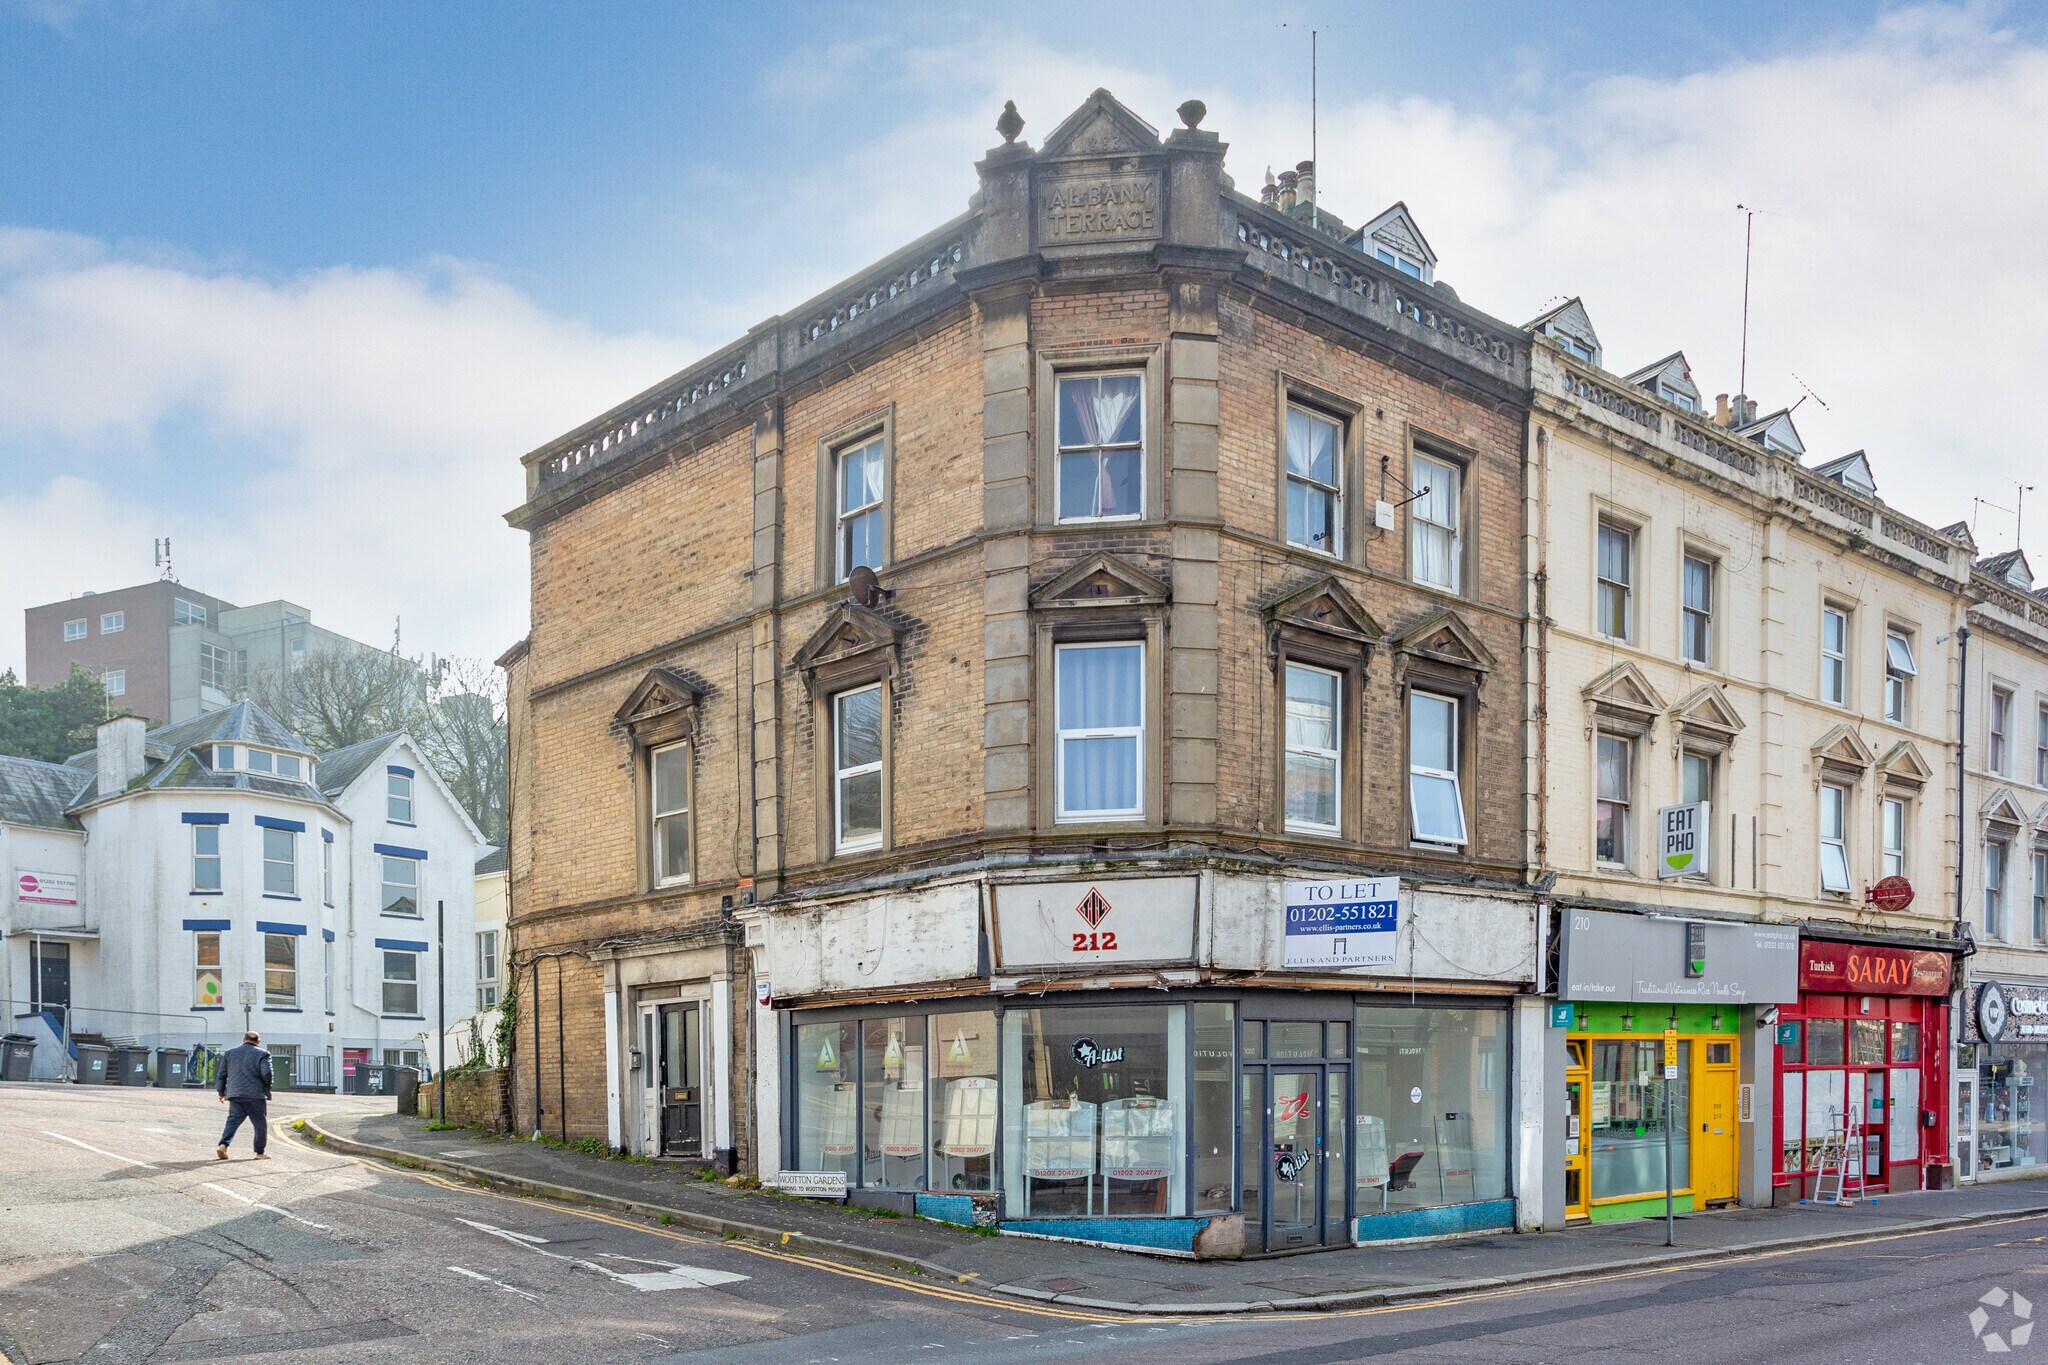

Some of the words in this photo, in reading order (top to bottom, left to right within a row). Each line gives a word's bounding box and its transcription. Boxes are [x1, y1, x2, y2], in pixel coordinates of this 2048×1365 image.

[1048, 182, 1152, 210] ALBANY
[1048, 209, 1153, 235] TERRACE
[1667, 808, 1694, 833] EAT
[1667, 832, 1694, 853] PHO
[1305, 885, 1333, 900] TO
[1340, 883, 1381, 899] LET
[1290, 904, 1394, 922] 01202-551821
[1300, 922, 1381, 932] www.ellis-partners.co.uk
[1574, 916, 1590, 931] 210
[1073, 932, 1118, 951] 212
[1809, 959, 1834, 972] Turkish
[1848, 954, 1912, 984] SARAY
[1913, 967, 1943, 980] Restaurant
[1571, 983, 1582, 992] eat
[1583, 982, 1604, 992] in/take
[1636, 980, 1669, 994] Traditional
[1729, 982, 1745, 1002] Soup
[1084, 1047, 1123, 1067] A-list
[781, 1176, 811, 1184] WOOTTON
[812, 1176, 844, 1185] GARDENS
